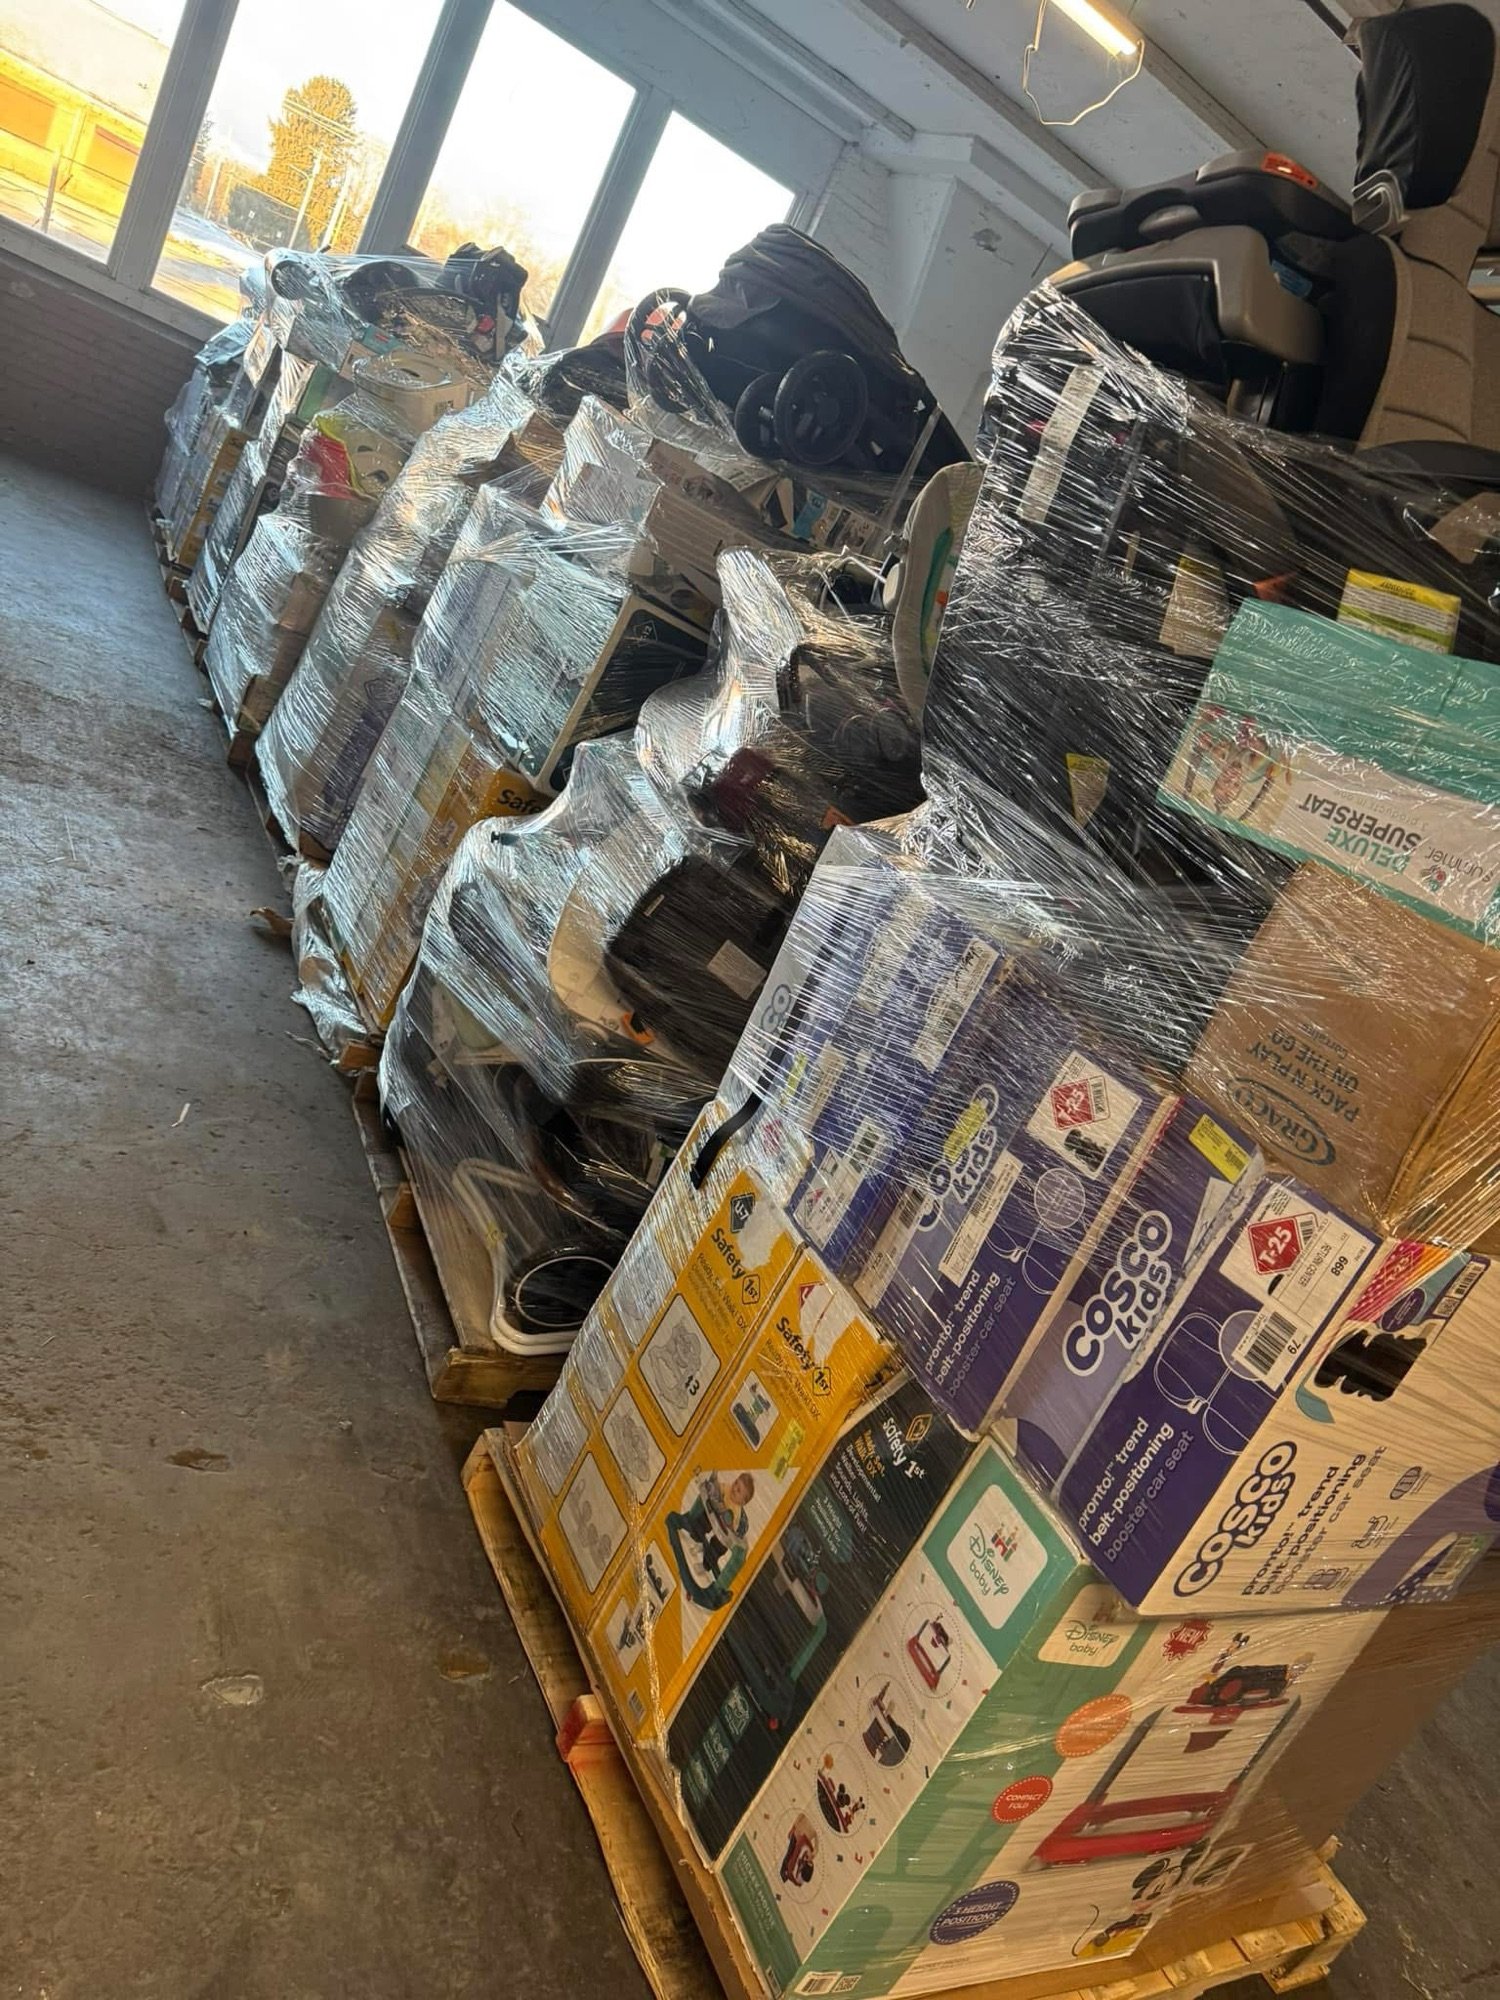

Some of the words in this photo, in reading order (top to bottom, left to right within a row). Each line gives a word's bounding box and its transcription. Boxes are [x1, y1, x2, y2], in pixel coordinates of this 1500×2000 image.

[1299, 793, 1421, 851] SUPERSEAT
[1324, 825, 1411, 875] DELUXE
[1247, 1041, 1293, 1077] PLAY
[1297, 1044, 1329, 1075] THE
[1235, 1087, 1318, 1153] GRACO
[1310, 1080, 1360, 1123] PACK
[711, 1227, 748, 1280] Safety
[1260, 1227, 1293, 1265] T-25
[1331, 1255, 1349, 1277] 668
[954, 1269, 980, 1312] trend
[1063, 1210, 1172, 1376] COSCO
[1114, 1262, 1170, 1346] kids
[776, 1316, 816, 1370] Safety
[935, 1272, 1001, 1386] belt-positioning
[946, 1339, 981, 1398] booster
[979, 1313, 996, 1339] car
[993, 1274, 1016, 1313] seat
[1287, 1339, 1301, 1355] 79
[1115, 1416, 1149, 1465] trend
[1089, 1422, 1175, 1546] belt-positioning
[1104, 1498, 1149, 1562] booster
[1146, 1469, 1167, 1500] car
[1165, 1430, 1195, 1471] seat
[1236, 1473, 1295, 1548] kids
[1298, 1466, 1340, 1519] trend
[1329, 1492, 1352, 1523] car
[1353, 1446, 1387, 1489] seat
[1174, 1440, 1297, 1597] COSCO
[1255, 1454, 1367, 1596] belt-positioning
[969, 1559, 991, 1596] baby
[1069, 1642, 1098, 1657] baby
